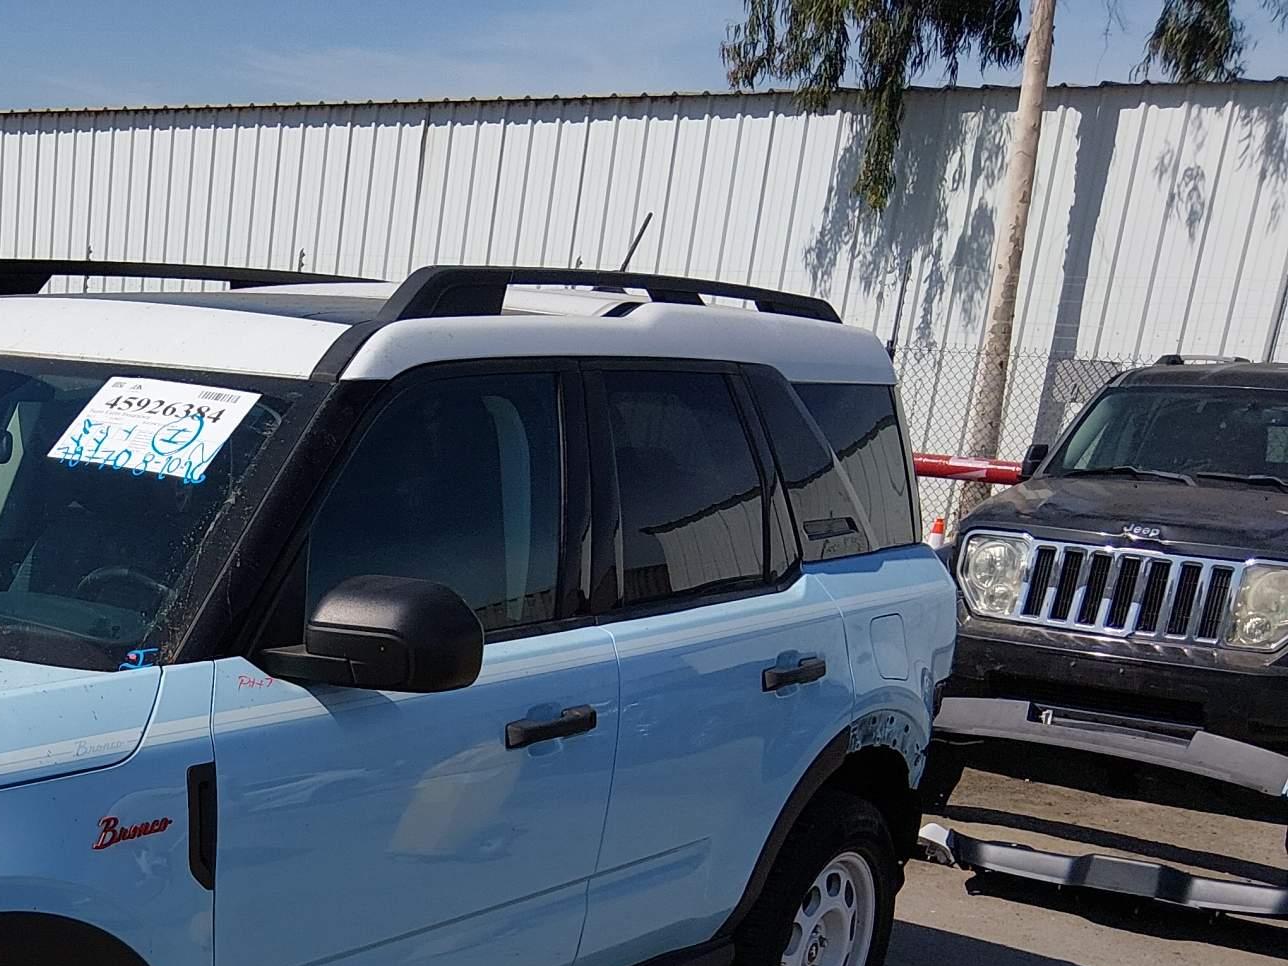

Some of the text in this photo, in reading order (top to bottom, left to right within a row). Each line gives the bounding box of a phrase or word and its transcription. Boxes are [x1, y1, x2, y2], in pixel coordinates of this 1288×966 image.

[105, 395, 226, 423] 45926384
[1123, 523, 1161, 537] Jeep
[73, 740, 123, 758] Bronco
[91, 815, 173, 850] Bronco
